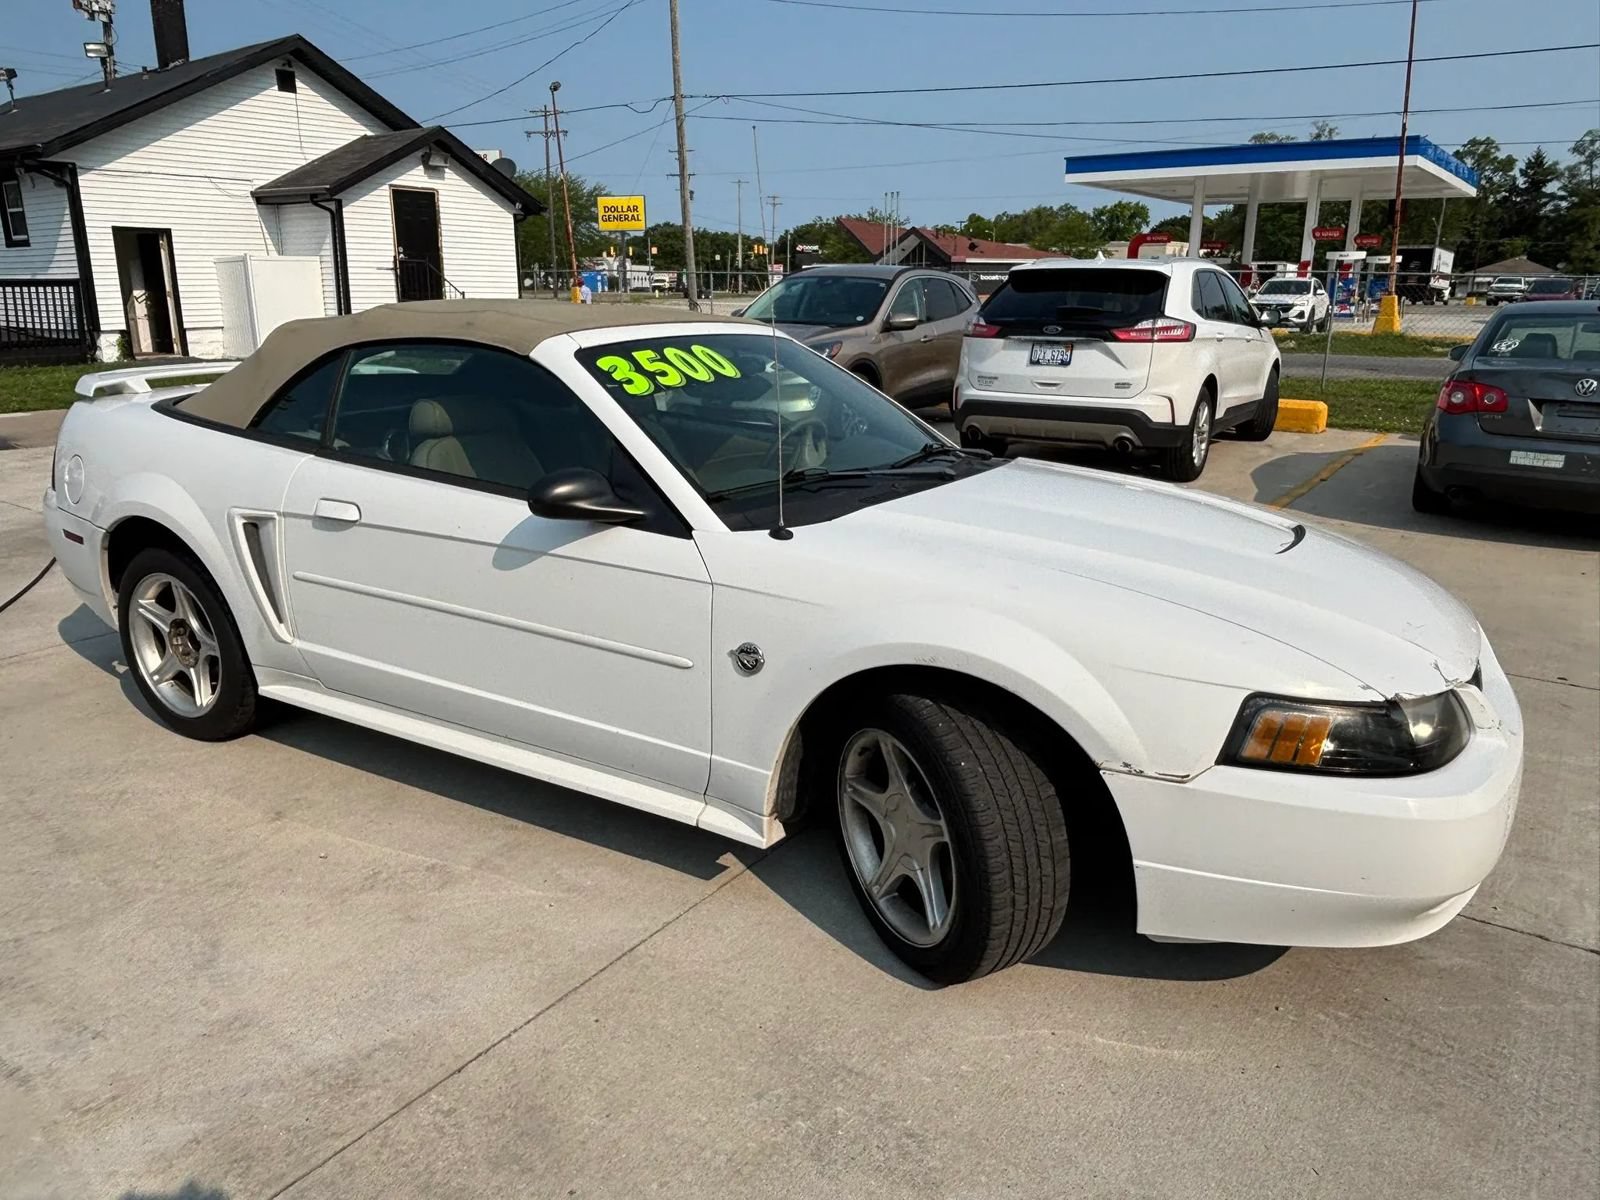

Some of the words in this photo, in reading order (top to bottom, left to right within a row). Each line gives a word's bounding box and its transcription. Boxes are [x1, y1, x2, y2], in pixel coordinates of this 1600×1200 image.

[603, 205, 639, 213] DOLLAR
[601, 214, 642, 222] GENERAL
[596, 345, 741, 396] 3500
